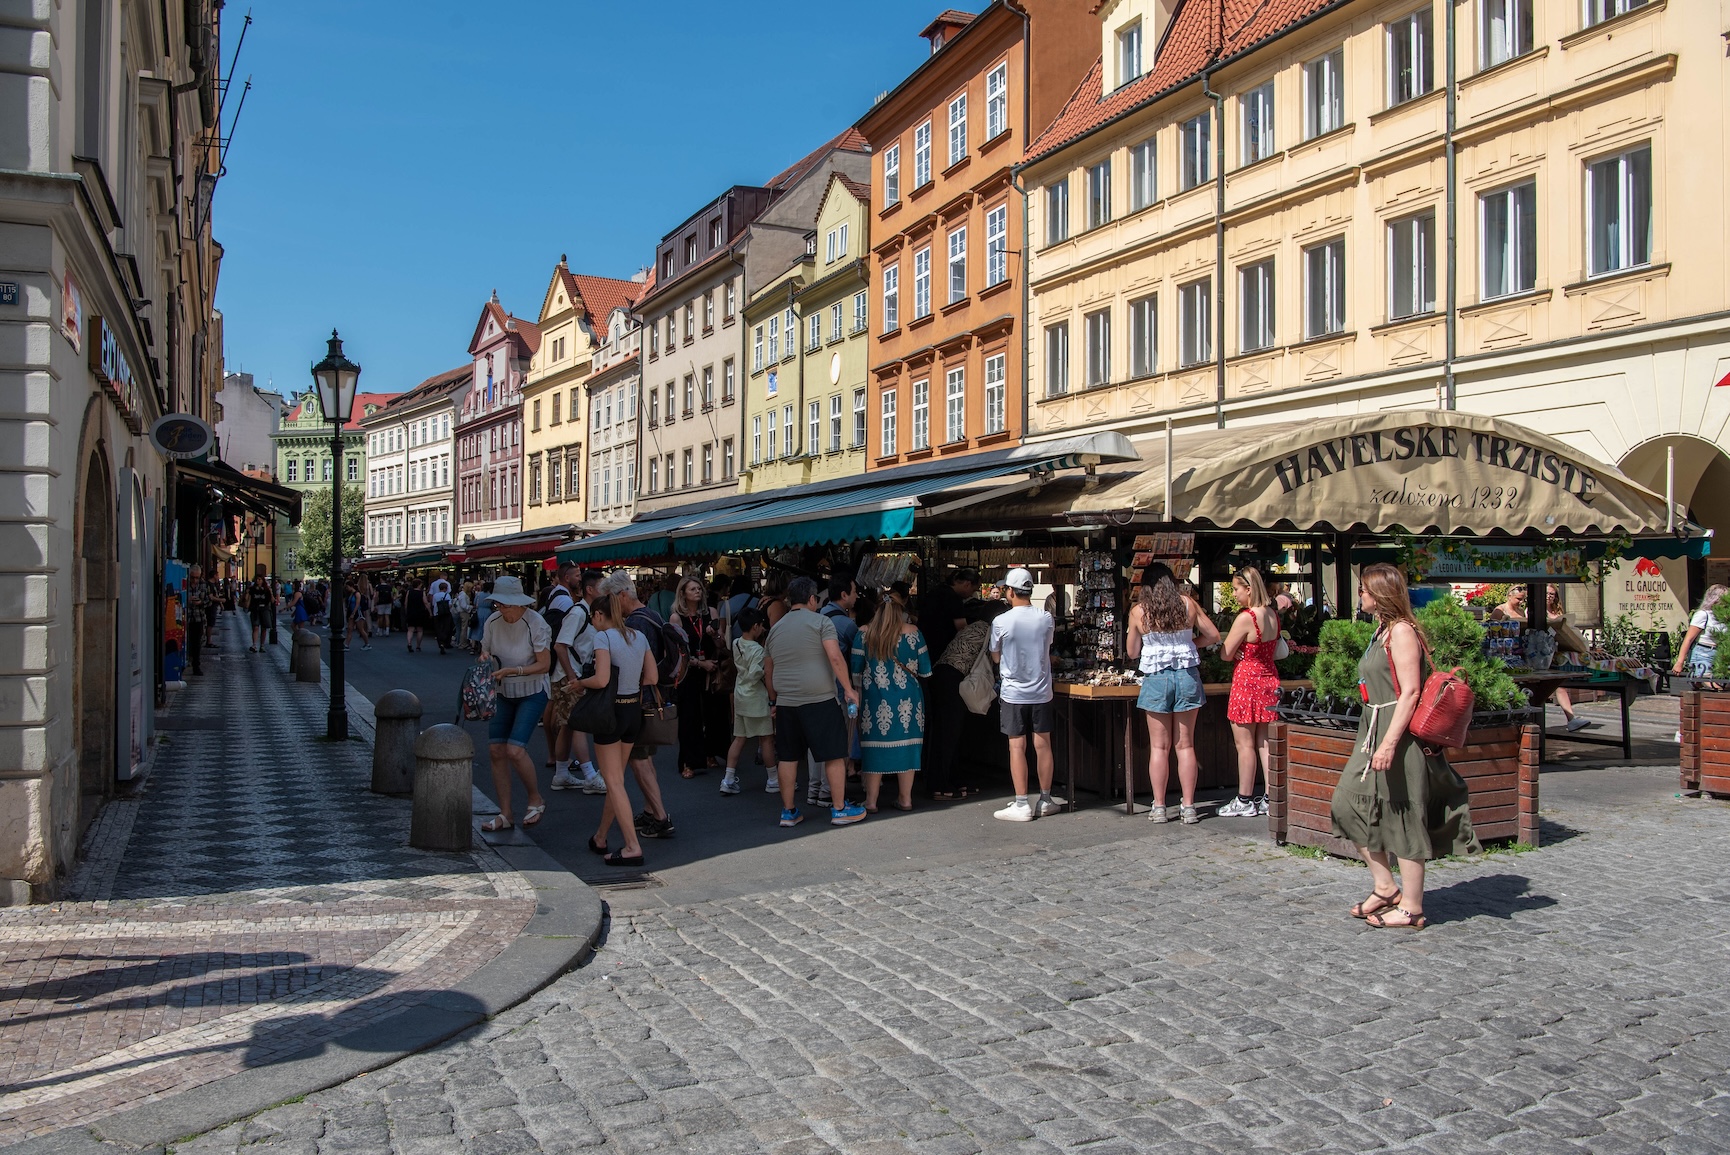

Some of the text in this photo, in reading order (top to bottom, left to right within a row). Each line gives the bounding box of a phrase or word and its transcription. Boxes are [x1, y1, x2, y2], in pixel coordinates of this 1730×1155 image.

[165, 450, 196, 459] HOTEL
[1370, 478, 1518, 509] založeno 1232
[1625, 581, 1667, 592] EL GAUCHO
[1619, 603, 1673, 611] THE PLACE FOR STEAK
